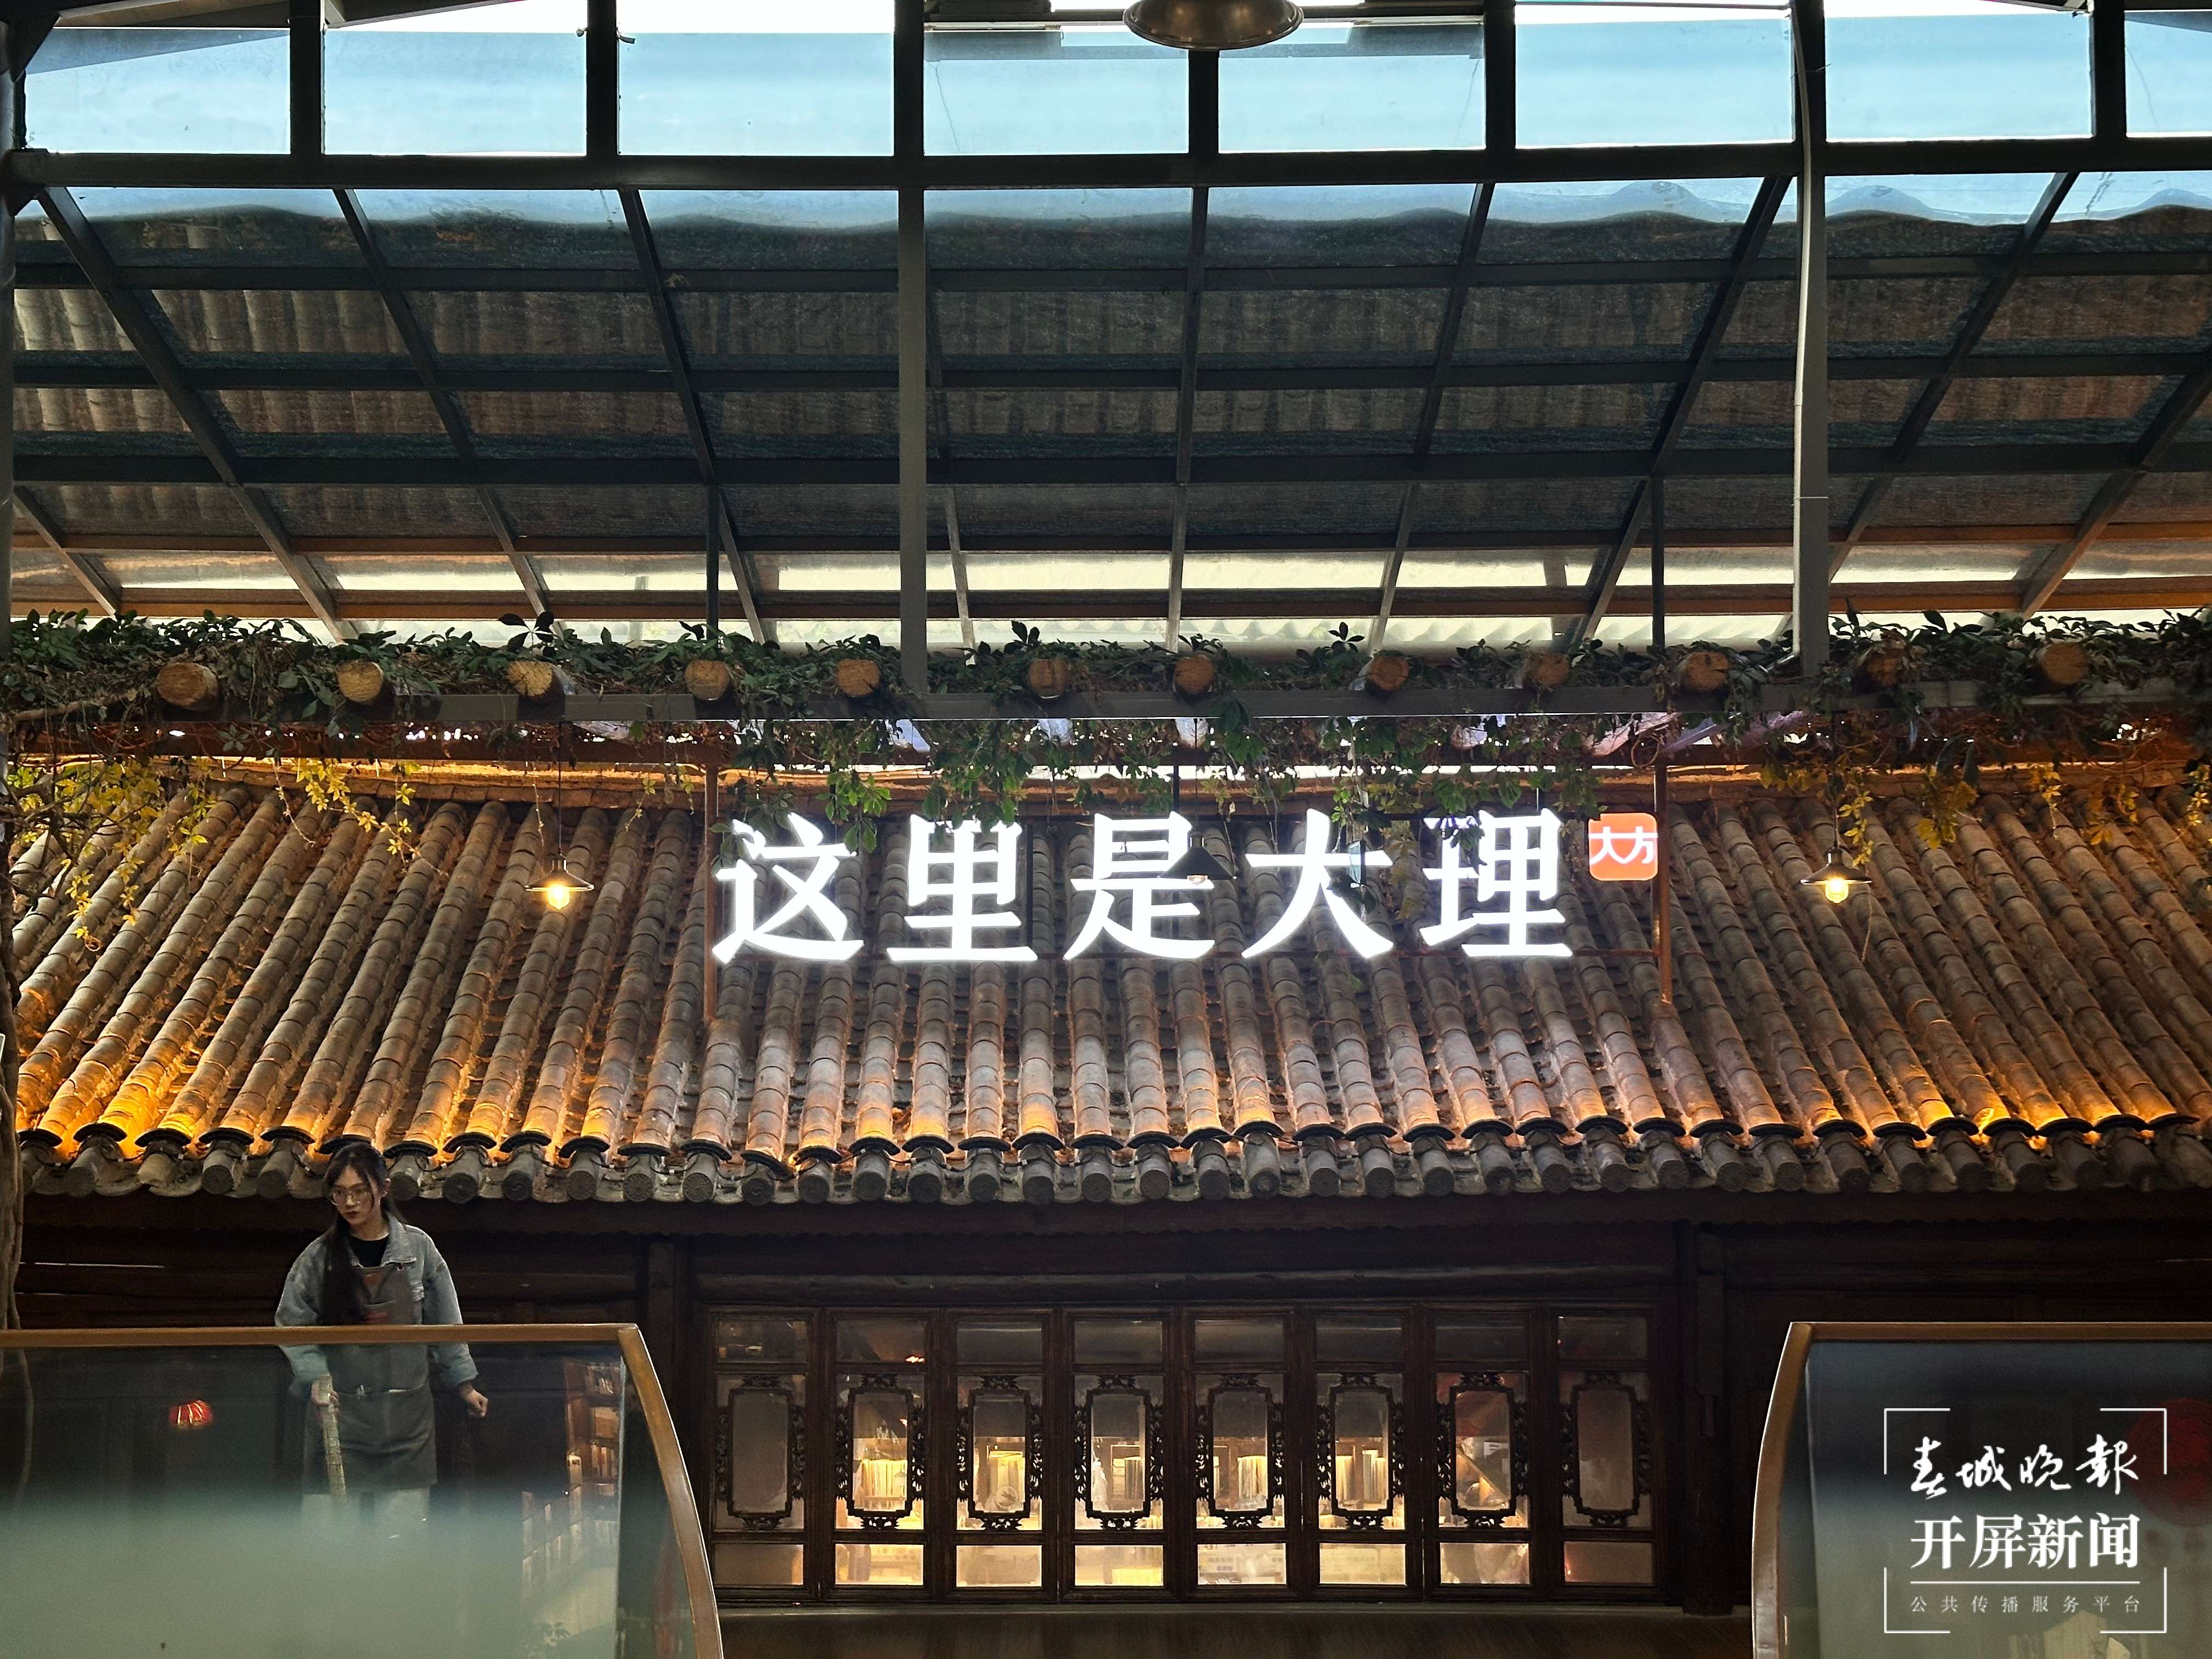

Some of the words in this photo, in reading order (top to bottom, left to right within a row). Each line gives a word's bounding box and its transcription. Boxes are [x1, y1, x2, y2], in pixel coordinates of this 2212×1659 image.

[712, 809, 1573, 961] 这里是大理
